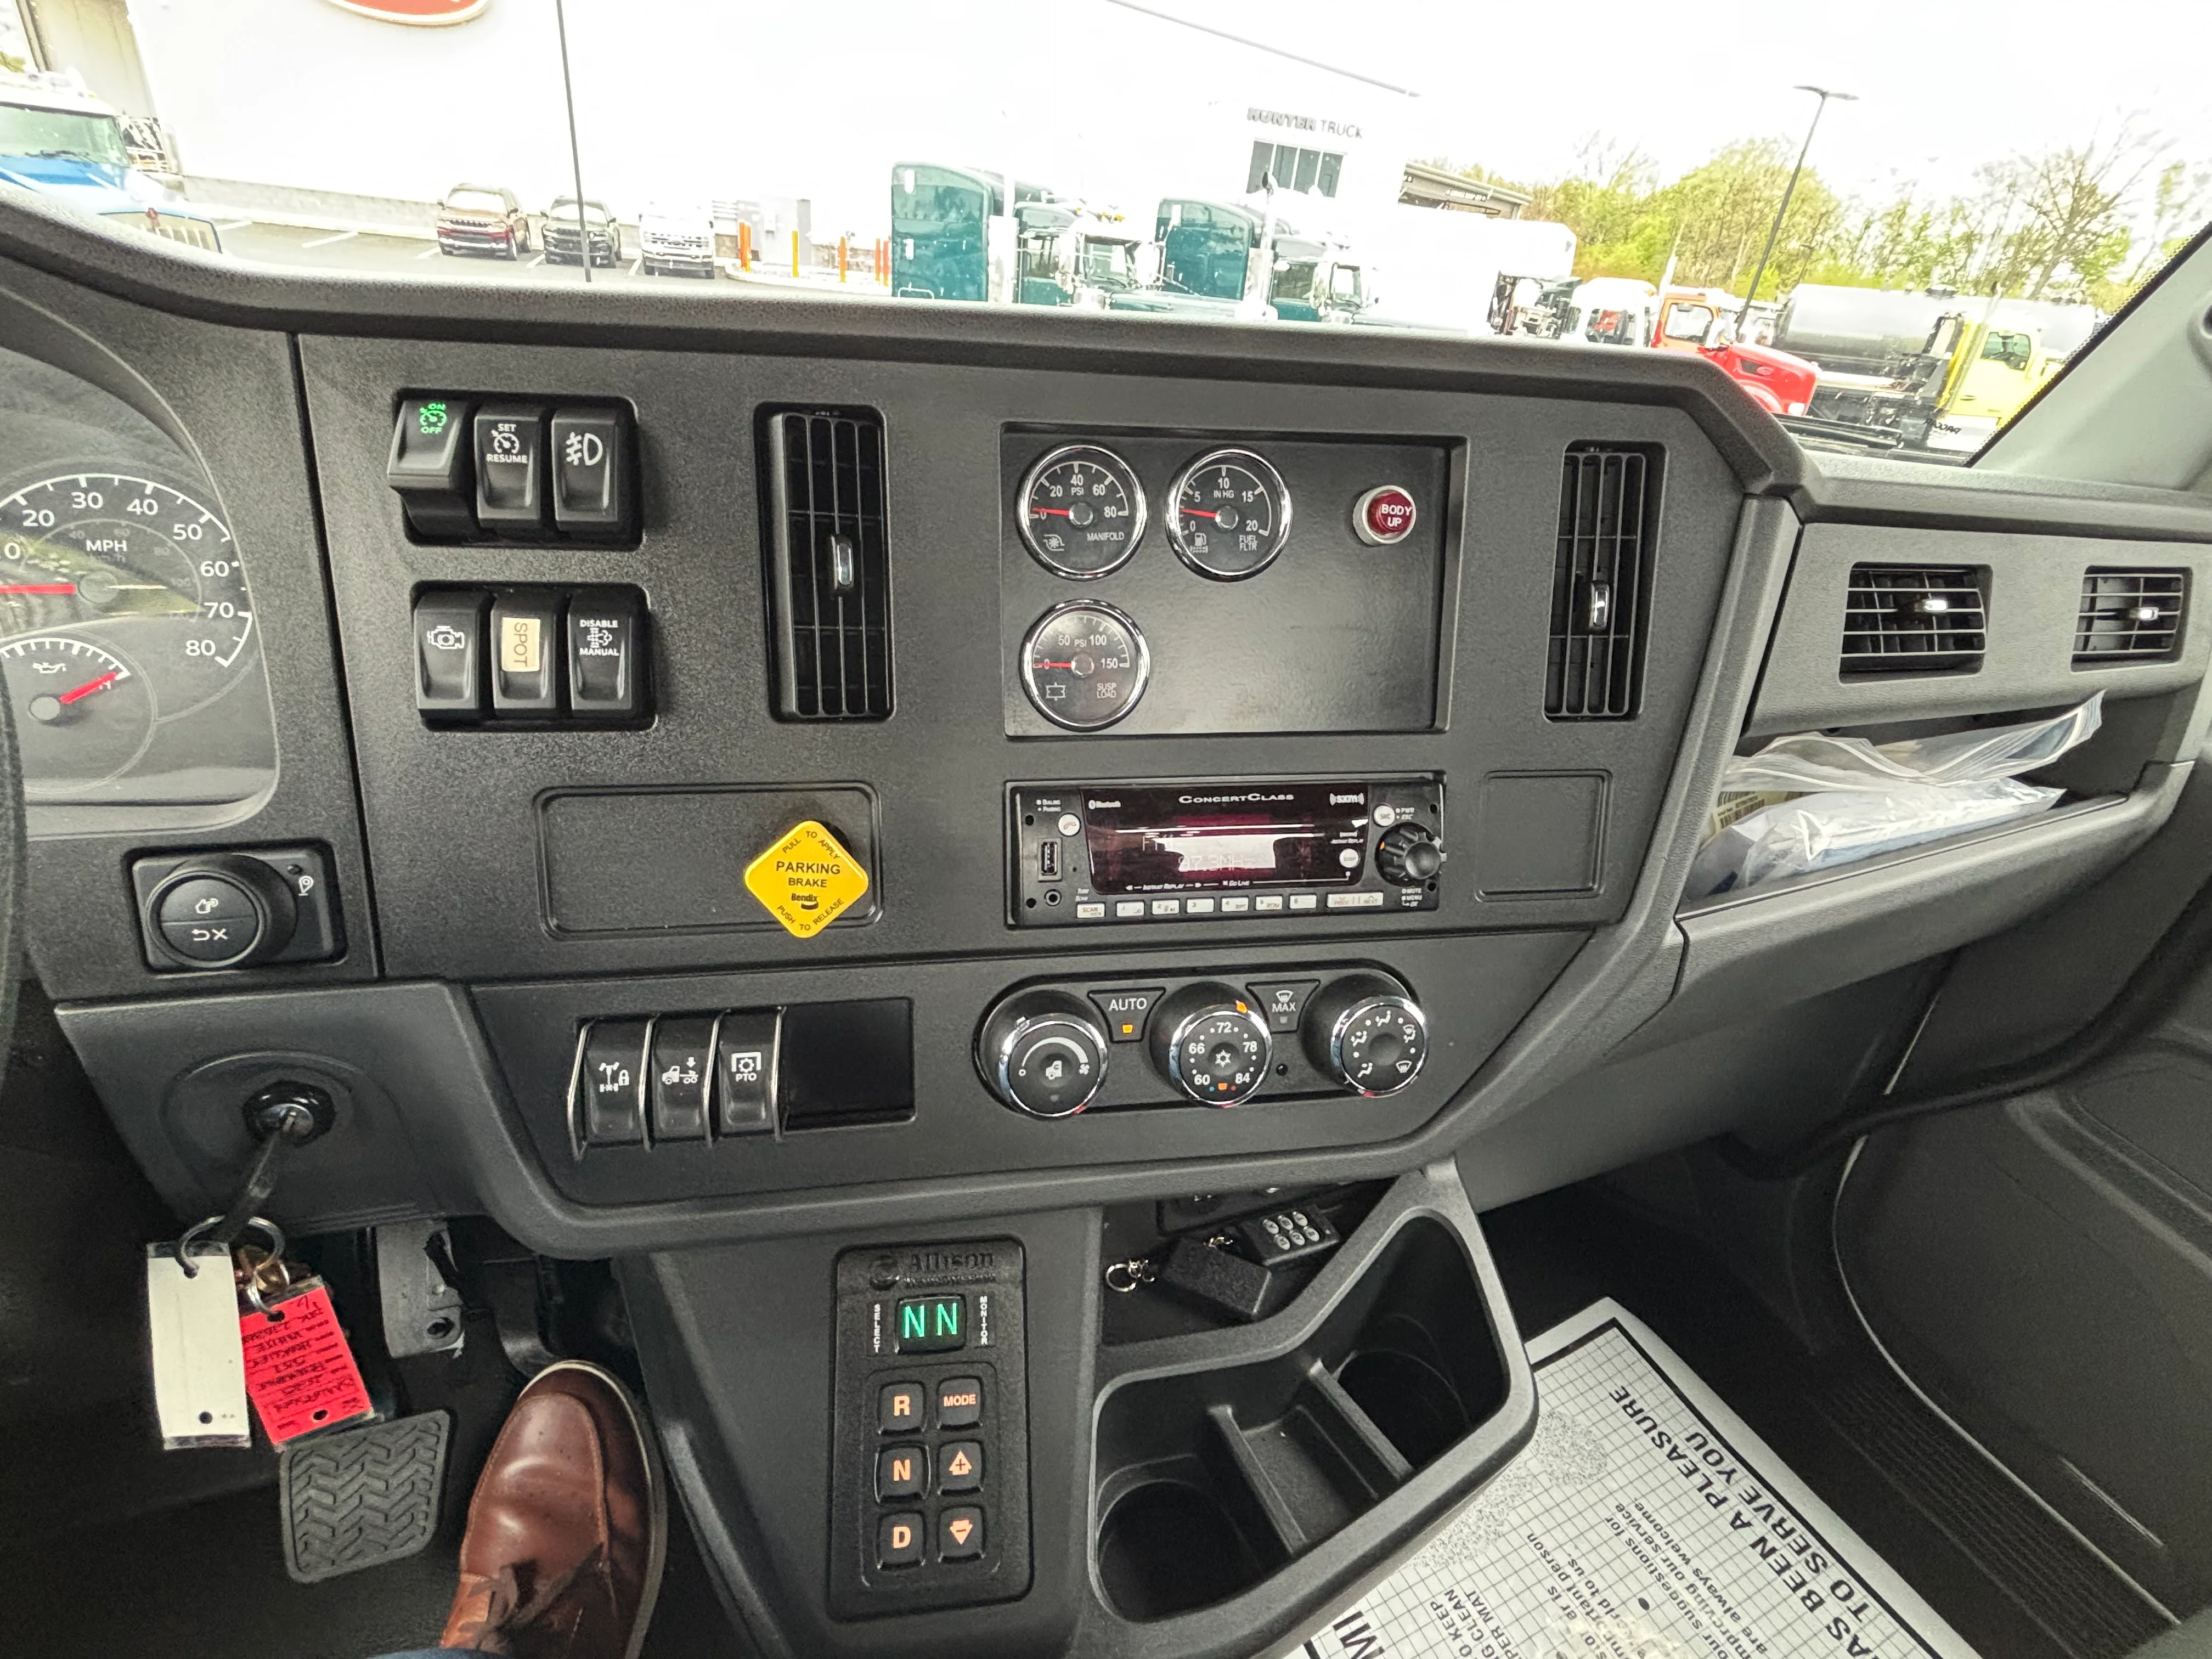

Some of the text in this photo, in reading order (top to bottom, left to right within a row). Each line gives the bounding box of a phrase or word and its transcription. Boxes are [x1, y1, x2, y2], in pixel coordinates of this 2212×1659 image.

[1321, 119, 1363, 139] TRUCK
[498, 424, 516, 432] SET
[487, 454, 528, 464] RESUME
[1070, 475, 1084, 486] 40
[1218, 478, 1230, 489] 10
[1049, 486, 1063, 497] 20
[1071, 487, 1084, 495] PSI
[1093, 484, 1105, 495] 60
[1222, 490, 1234, 498] HG
[71, 492, 103, 509] 30
[1194, 492, 1201, 503] 5
[1242, 491, 1254, 503] 15
[127, 499, 159, 515] 40
[1104, 506, 1117, 517] 80
[1381, 504, 1413, 516] BODY
[22, 510, 55, 527] 20
[1387, 517, 1402, 527] UP
[173, 524, 202, 540] 50
[1189, 521, 1196, 532] 0
[1246, 520, 1258, 531] 20
[1087, 532, 1125, 541] MANIFOLD
[86, 539, 128, 552] MPH
[1239, 543, 1257, 551] FLTR
[200, 561, 230, 577] 60
[204, 602, 234, 618] 70
[579, 619, 618, 628] DISABLE
[514, 622, 528, 667] SPOT
[1058, 634, 1070, 646] 50
[1074, 639, 1087, 647] PSI
[1090, 634, 1107, 646] 100
[185, 640, 216, 656] 80
[579, 647, 619, 656] MANUAL
[1101, 658, 1118, 669] 150
[1097, 691, 1116, 699] LOAD
[782, 831, 841, 860] PULL TO APPLY
[776, 861, 840, 875] PARKING
[788, 877, 828, 888] BRAKE
[791, 893, 818, 902] Bendix
[776, 905, 796, 924] PUSH
[812, 898, 845, 925] RELEASE
[1108, 997, 1147, 1011] AUTO
[1272, 1002, 1296, 1012] MAX
[1216, 1022, 1232, 1034] 72
[1188, 1043, 1205, 1054] 66
[1243, 1041, 1257, 1052] 78
[735, 1072, 757, 1082] PTO
[1194, 1074, 1210, 1085] 60
[1235, 1073, 1250, 1084] 84
[904, 1302, 958, 1339] N N
[980, 1296, 988, 1345] MONITOR
[893, 1395, 910, 1416] R
[944, 1394, 976, 1407] MODE
[1608, 1383, 1729, 1509] PLEASURE
[893, 1459, 910, 1481] N
[1605, 1516, 1624, 1536] for
[1615, 1503, 1661, 1553] service
[1685, 1428, 1874, 1621] TO SERVE YOU
[1728, 1509, 1752, 1534] A
[893, 1526, 911, 1548] D
[1527, 1533, 1570, 1581] person
[1658, 1553, 1684, 1580] our
[1750, 1533, 1826, 1613] BEEN
[1585, 1579, 1599, 1595] to
[1626, 1538, 1702, 1629] suggestions
[1547, 1586, 1560, 1600] is
[1692, 1567, 1740, 1622] always
[1465, 1589, 1492, 1622] MAT
[1430, 1599, 1462, 1640] KEEP
[1444, 1590, 1483, 1642] CLEAN
[1742, 1627, 1767, 1654] are
